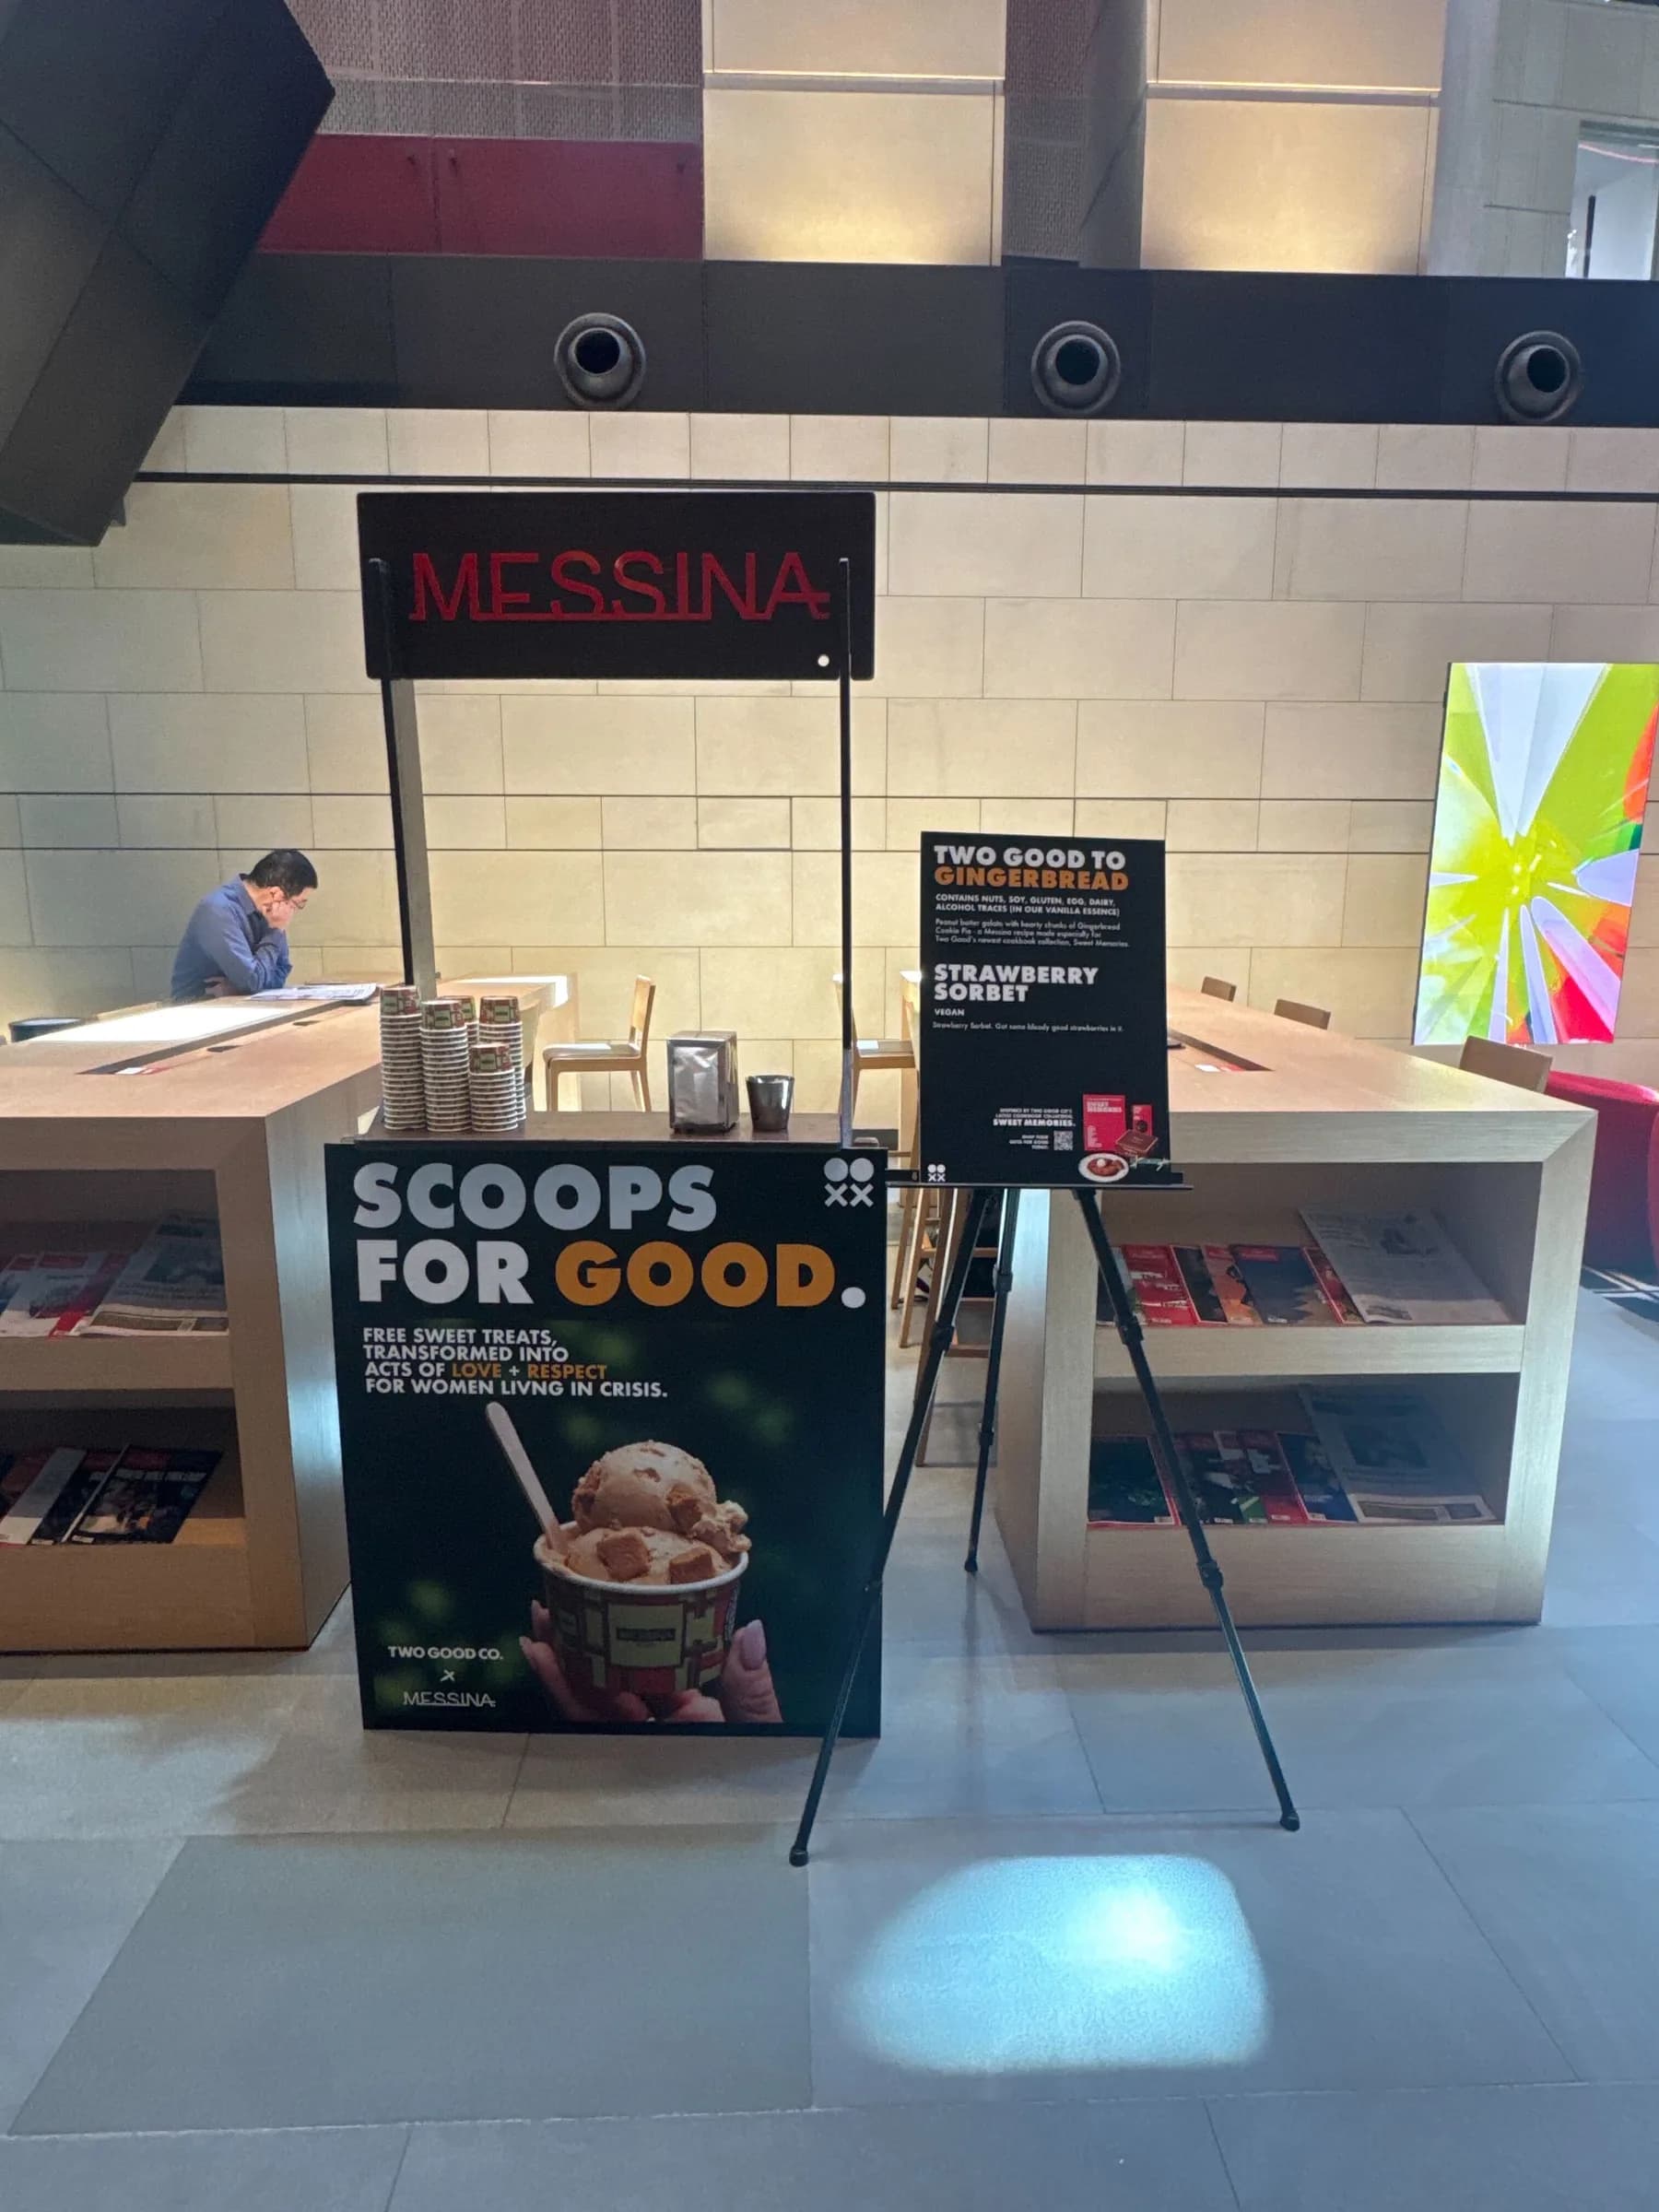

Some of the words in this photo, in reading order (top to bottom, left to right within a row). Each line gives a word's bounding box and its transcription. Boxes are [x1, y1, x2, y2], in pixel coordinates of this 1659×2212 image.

[409, 549, 830, 621] MESSINA
[934, 844, 996, 866] TWO
[1003, 847, 1086, 868] GOOD
[1091, 850, 1126, 870] TO
[934, 866, 1129, 891] GINGERBREAD
[935, 893, 979, 902] CONTAINS
[982, 895, 1006, 904] NUTS,
[1088, 898, 1115, 908] DAIRY,
[935, 903, 975, 912] ALCOHOL
[977, 904, 1007, 912] TRACES
[1024, 906, 1042, 914] OUR
[1045, 906, 1080, 915] VANILLA
[1082, 907, 1120, 918] ESSENCE)
[934, 963, 1100, 985] STRAWBERRY
[934, 982, 1029, 1003] SORBET
[935, 1008, 965, 1017] VEGAN
[993, 1118, 1022, 1126] SWEET
[1024, 1119, 1077, 1127] MEMORIES.
[353, 1162, 717, 1232] SCOOPS
[356, 1238, 534, 1305] FOR
[555, 1240, 866, 1309] GOOD.
[362, 1327, 406, 1343] FREE
[413, 1328, 477, 1344] SWEET
[481, 1329, 558, 1347] TREATS,
[362, 1345, 513, 1361] TRANSFORMED
[519, 1347, 569, 1362] INTO
[365, 1361, 412, 1377] ACTS
[418, 1362, 445, 1377] OF
[452, 1362, 502, 1378] LOVE
[527, 1364, 607, 1380] RESPECT
[366, 1378, 406, 1394] FOR
[411, 1379, 494, 1394] WOMEN
[571, 1381, 593, 1396] IN
[600, 1382, 668, 1397] CRISIS.
[387, 1645, 426, 1658] TWO
[427, 1646, 477, 1659] GOOD
[477, 1648, 504, 1660] CO.
[403, 1691, 497, 1708] MESSINA
